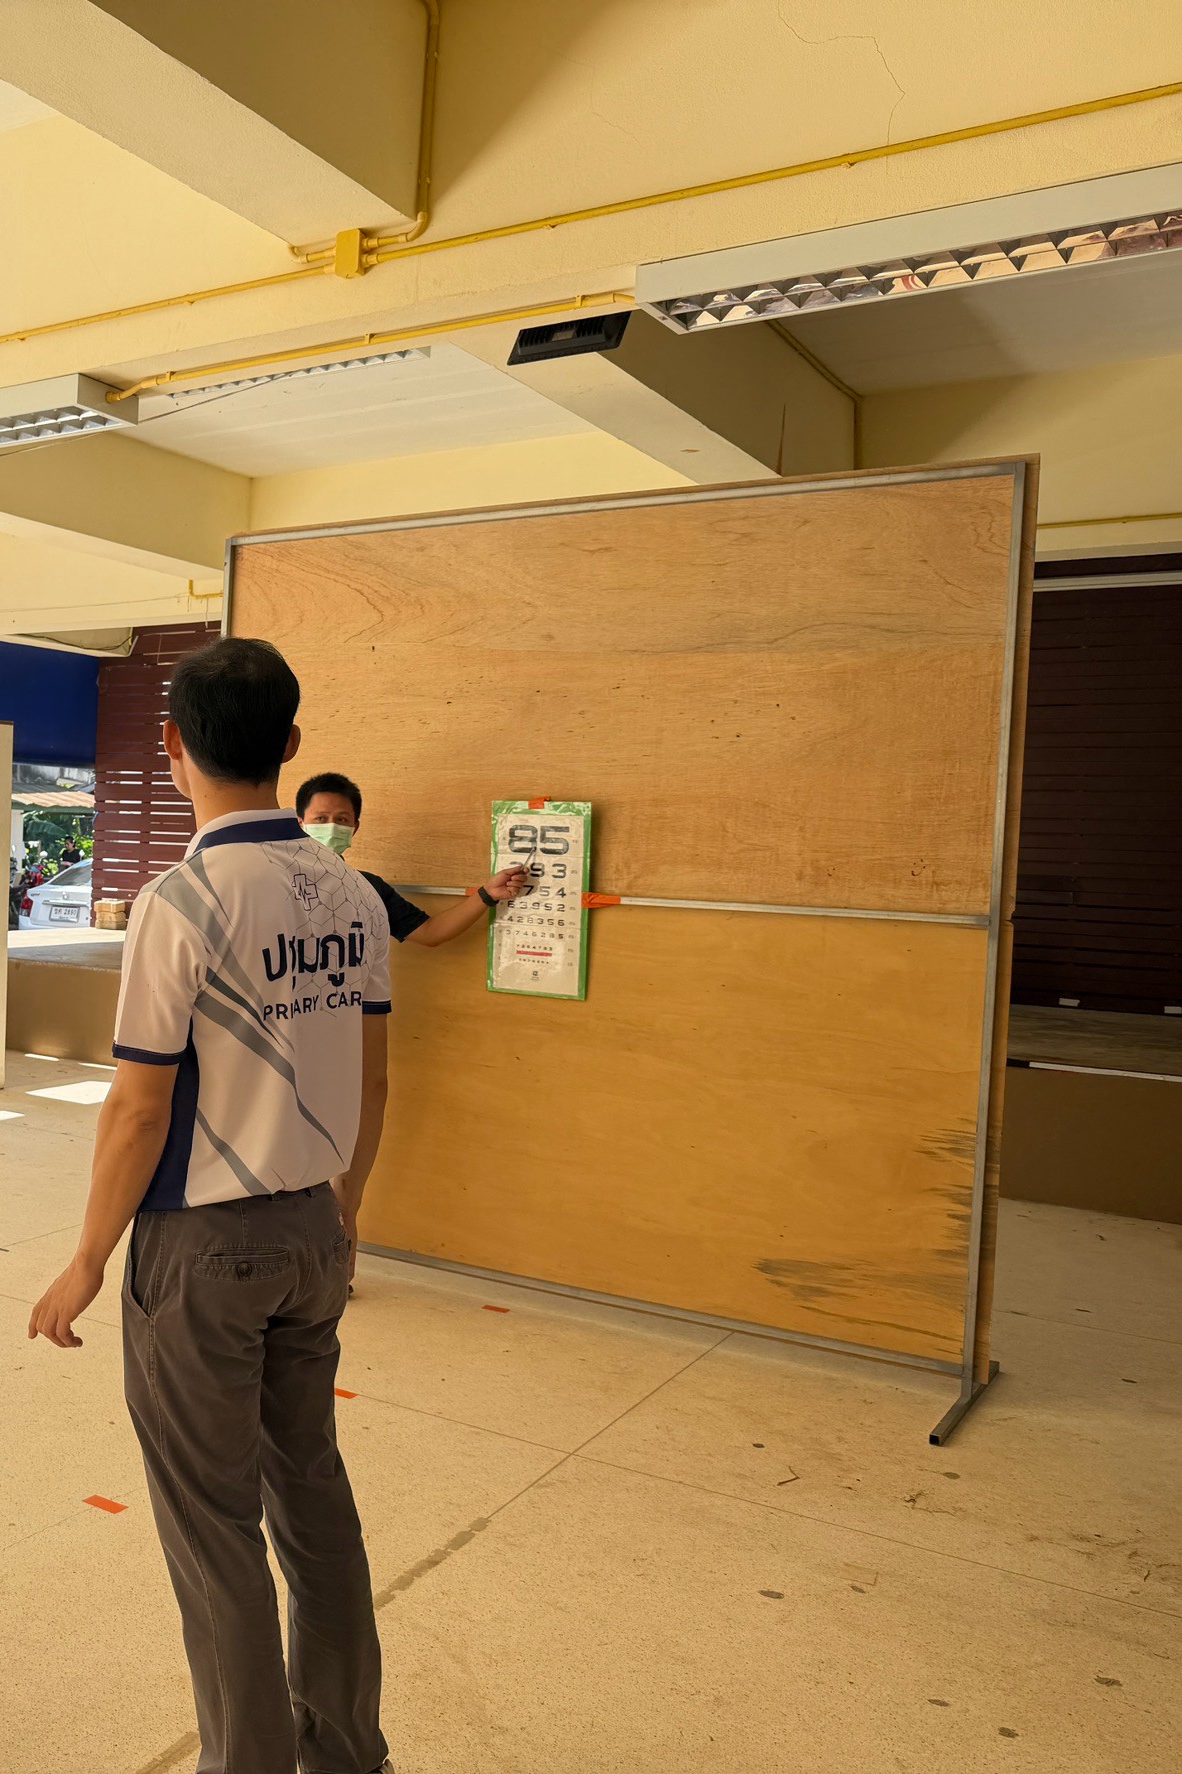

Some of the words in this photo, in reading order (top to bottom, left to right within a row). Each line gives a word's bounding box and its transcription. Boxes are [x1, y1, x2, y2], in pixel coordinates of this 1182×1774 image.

[508, 825, 570, 855] 85
[509, 861, 567, 879] 93
[263, 995, 320, 1021] PRIARY
[326, 991, 362, 1009] CAR
